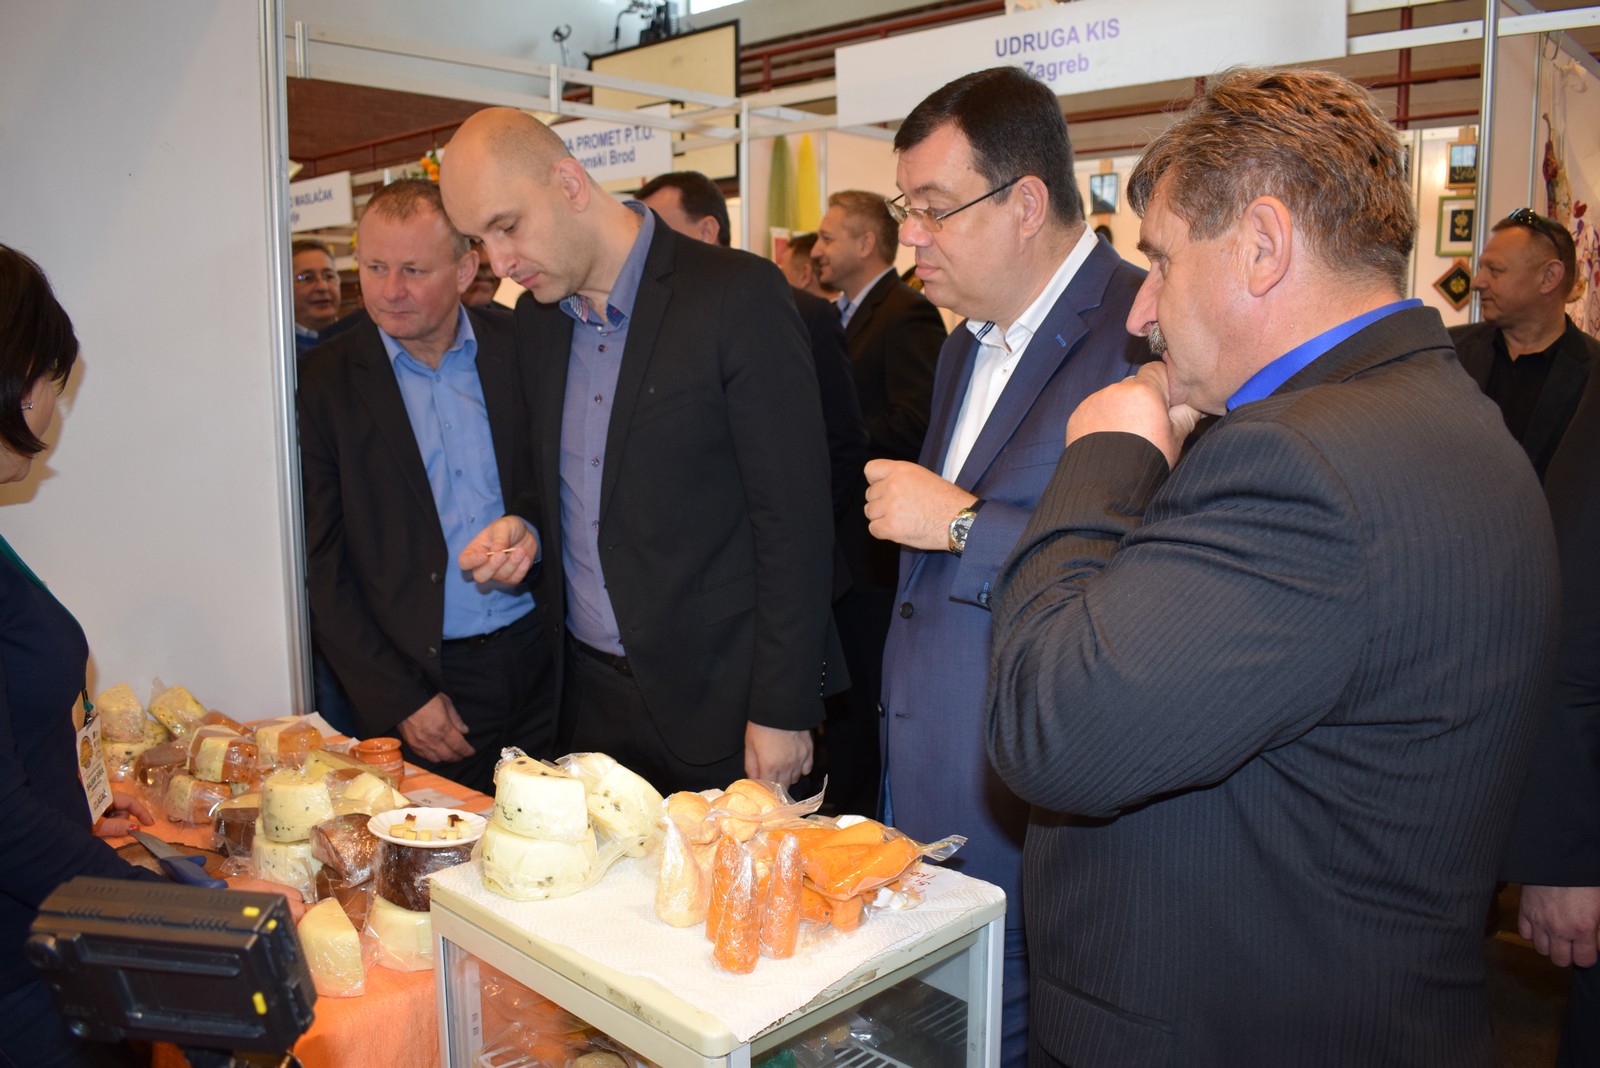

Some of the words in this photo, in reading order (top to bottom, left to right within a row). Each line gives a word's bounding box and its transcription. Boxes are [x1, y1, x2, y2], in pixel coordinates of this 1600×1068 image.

[995, 25, 1080, 57] UDRUGA
[1086, 18, 1120, 42] KIS
[1024, 53, 1089, 81] Zagreb
[576, 129, 622, 152] PROMET
[609, 146, 635, 165] Brod
